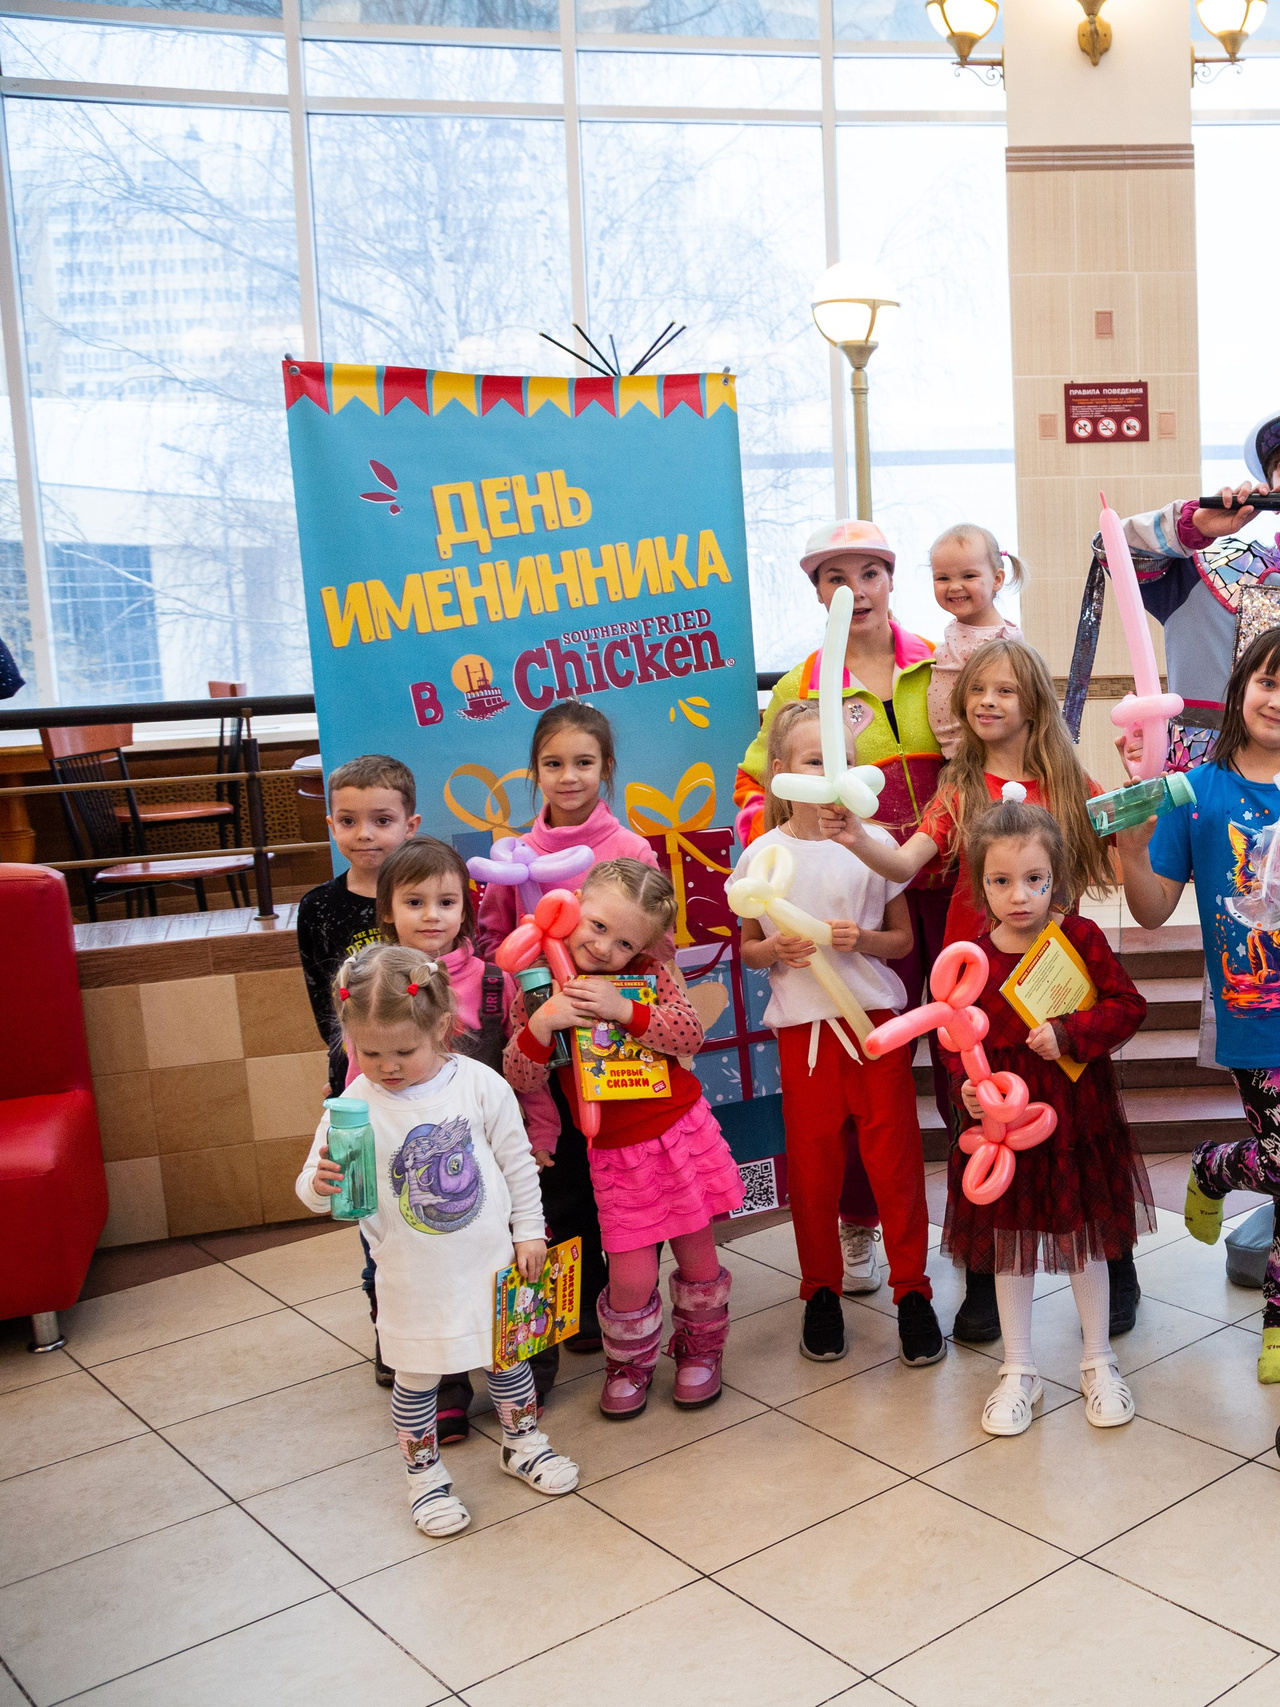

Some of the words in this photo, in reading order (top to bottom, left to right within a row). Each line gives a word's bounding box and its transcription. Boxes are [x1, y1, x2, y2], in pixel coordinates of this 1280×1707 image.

[1069, 388, 1101, 396] ПРАВИЛА
[1102, 387, 1144, 395] ПОВЕДЕНИЯ
[431, 469, 593, 559] ДЕНЬ
[321, 529, 732, 649] ИМЕНИННИКА
[562, 620, 640, 645] SOUTHERN
[641, 608, 712, 638] FRIED
[513, 629, 726, 711] Chicken
[353, 931, 367, 940] THE
[606, 1078, 649, 1088] СКАЗКИ
[610, 1069, 643, 1077] ПЕРВЫЕ
[567, 1264, 575, 1313] СКАЗКИ
